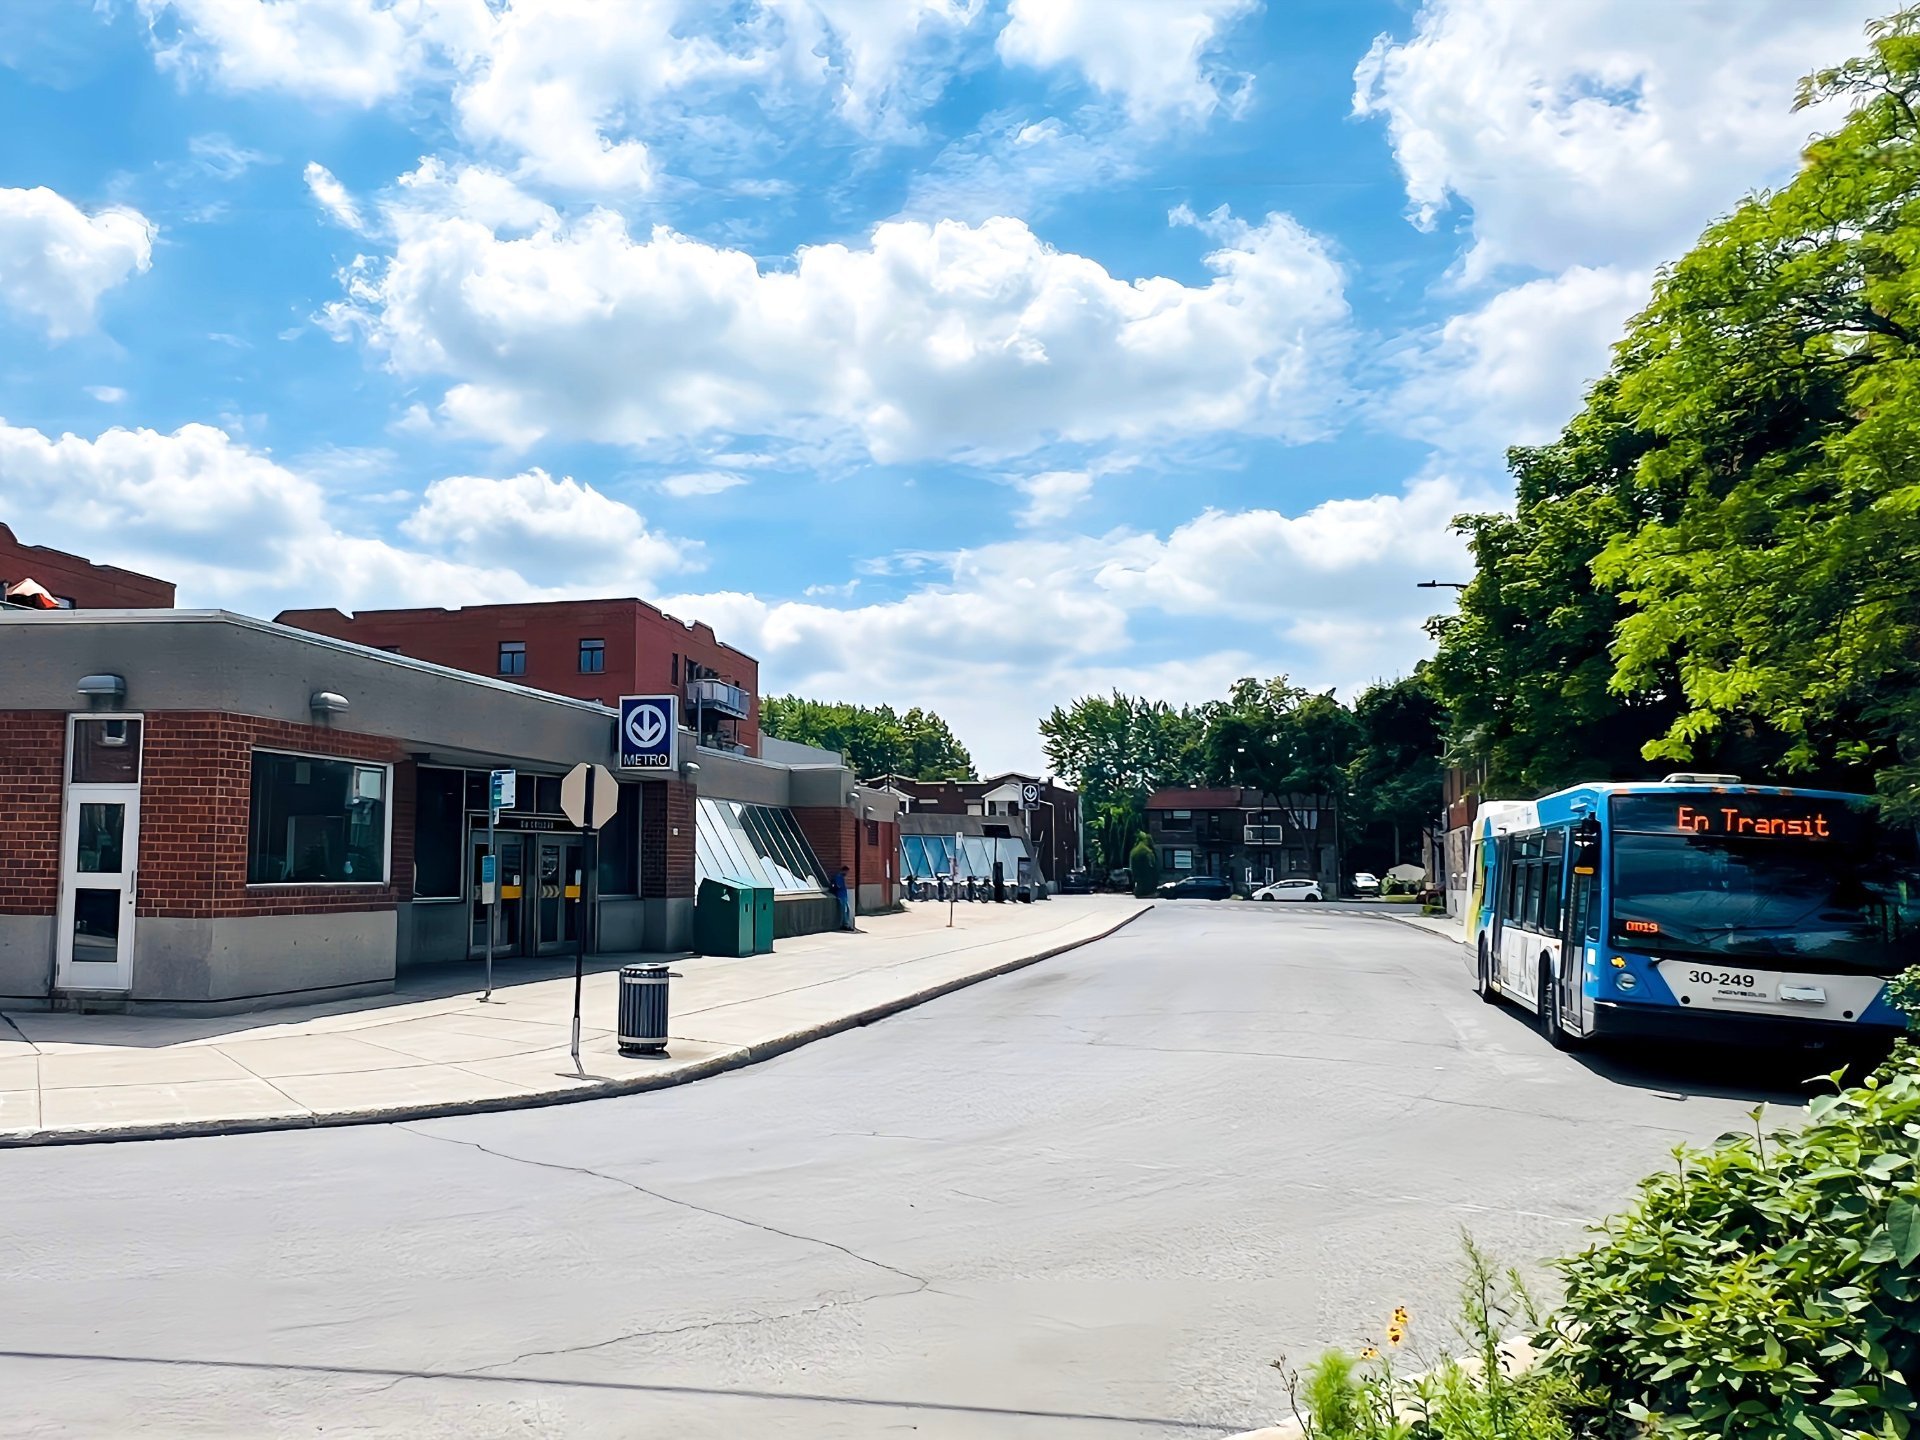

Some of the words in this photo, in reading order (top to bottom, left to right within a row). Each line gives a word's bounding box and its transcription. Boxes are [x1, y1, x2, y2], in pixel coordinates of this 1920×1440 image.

[623, 753, 668, 766] METRO
[1678, 805, 1709, 831] En
[1720, 808, 1830, 837] Transit
[1688, 970, 1755, 988] 30-249
